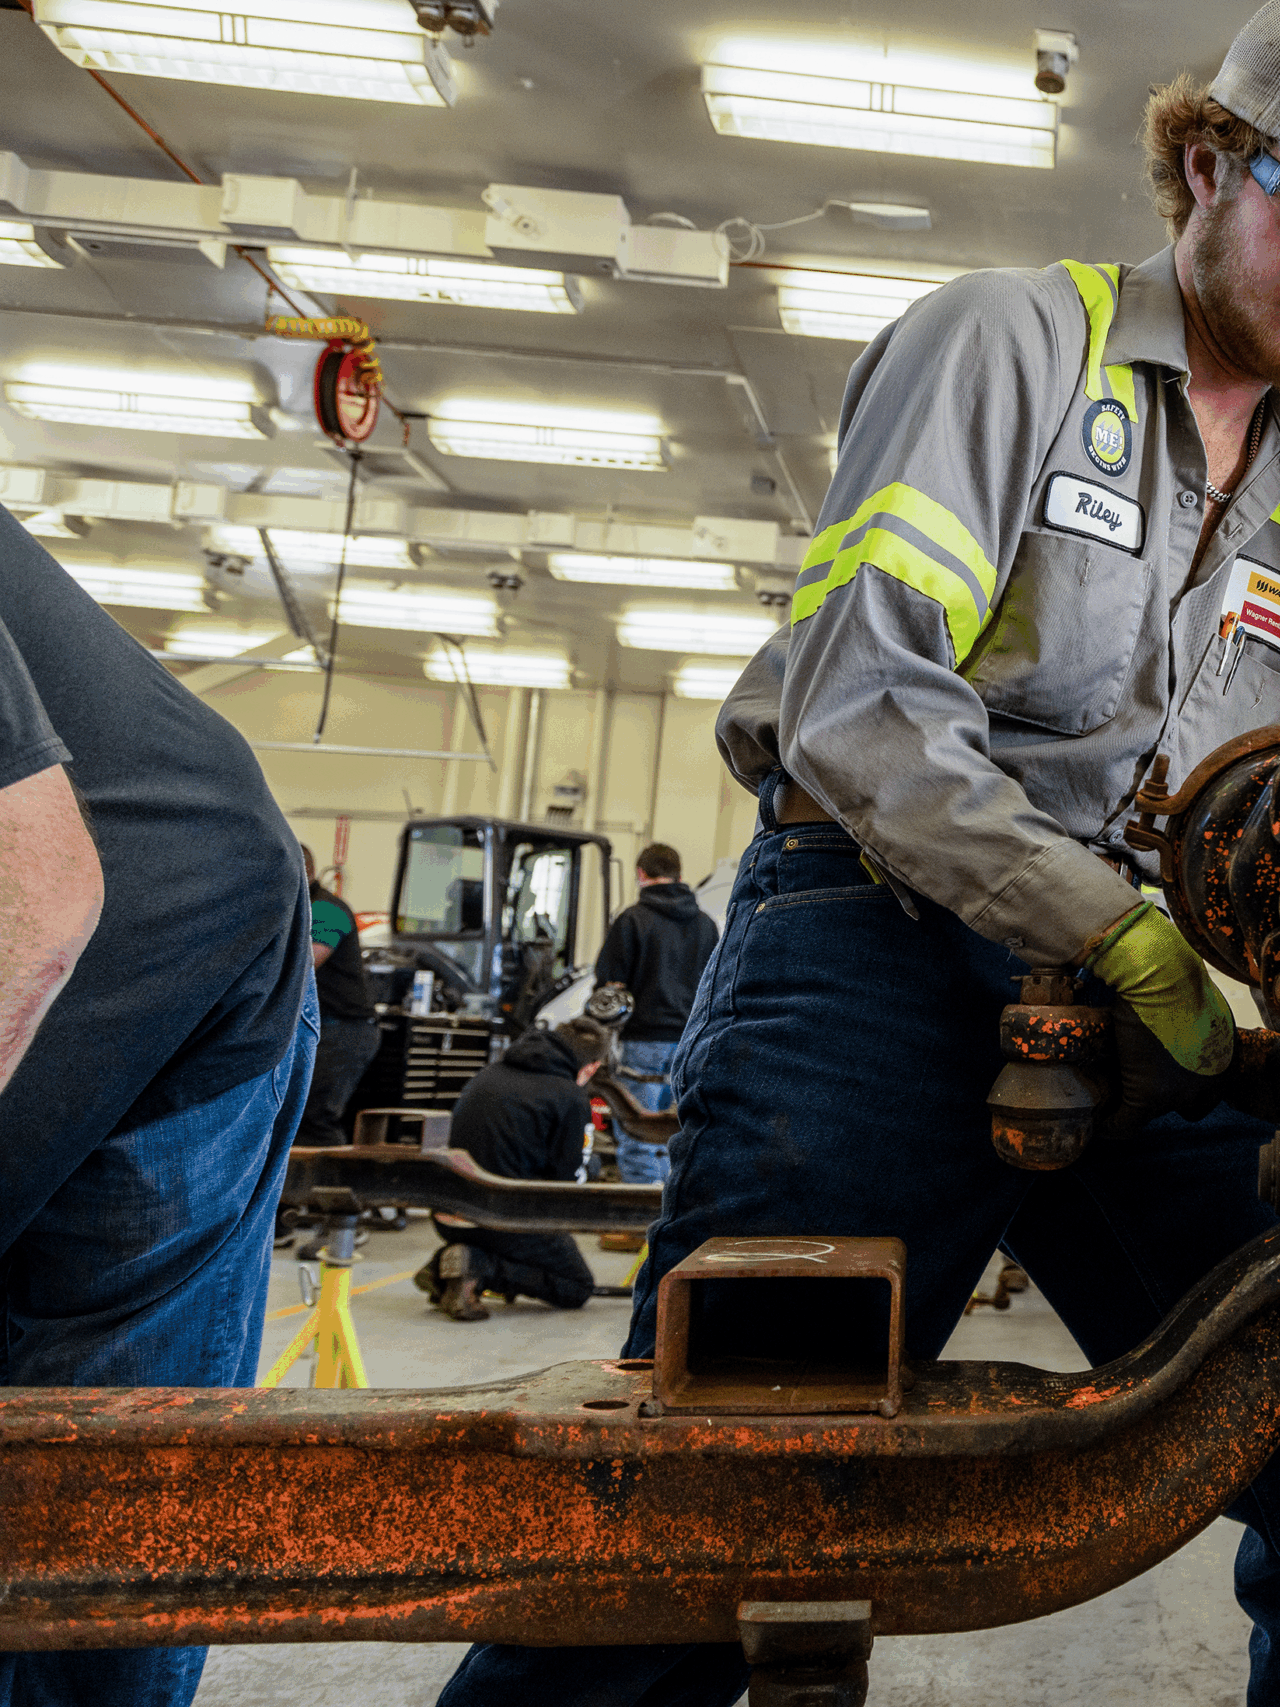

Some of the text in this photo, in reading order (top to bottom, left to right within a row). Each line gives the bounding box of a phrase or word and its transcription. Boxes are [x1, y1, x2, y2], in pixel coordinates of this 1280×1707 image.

[1101, 404, 1126, 420] SAFETY
[1095, 426, 1123, 450] ME!
[1088, 445, 1127, 471] BEGINS WITH
[1075, 492, 1123, 532] Riley
[1246, 608, 1268, 622] Wagner
